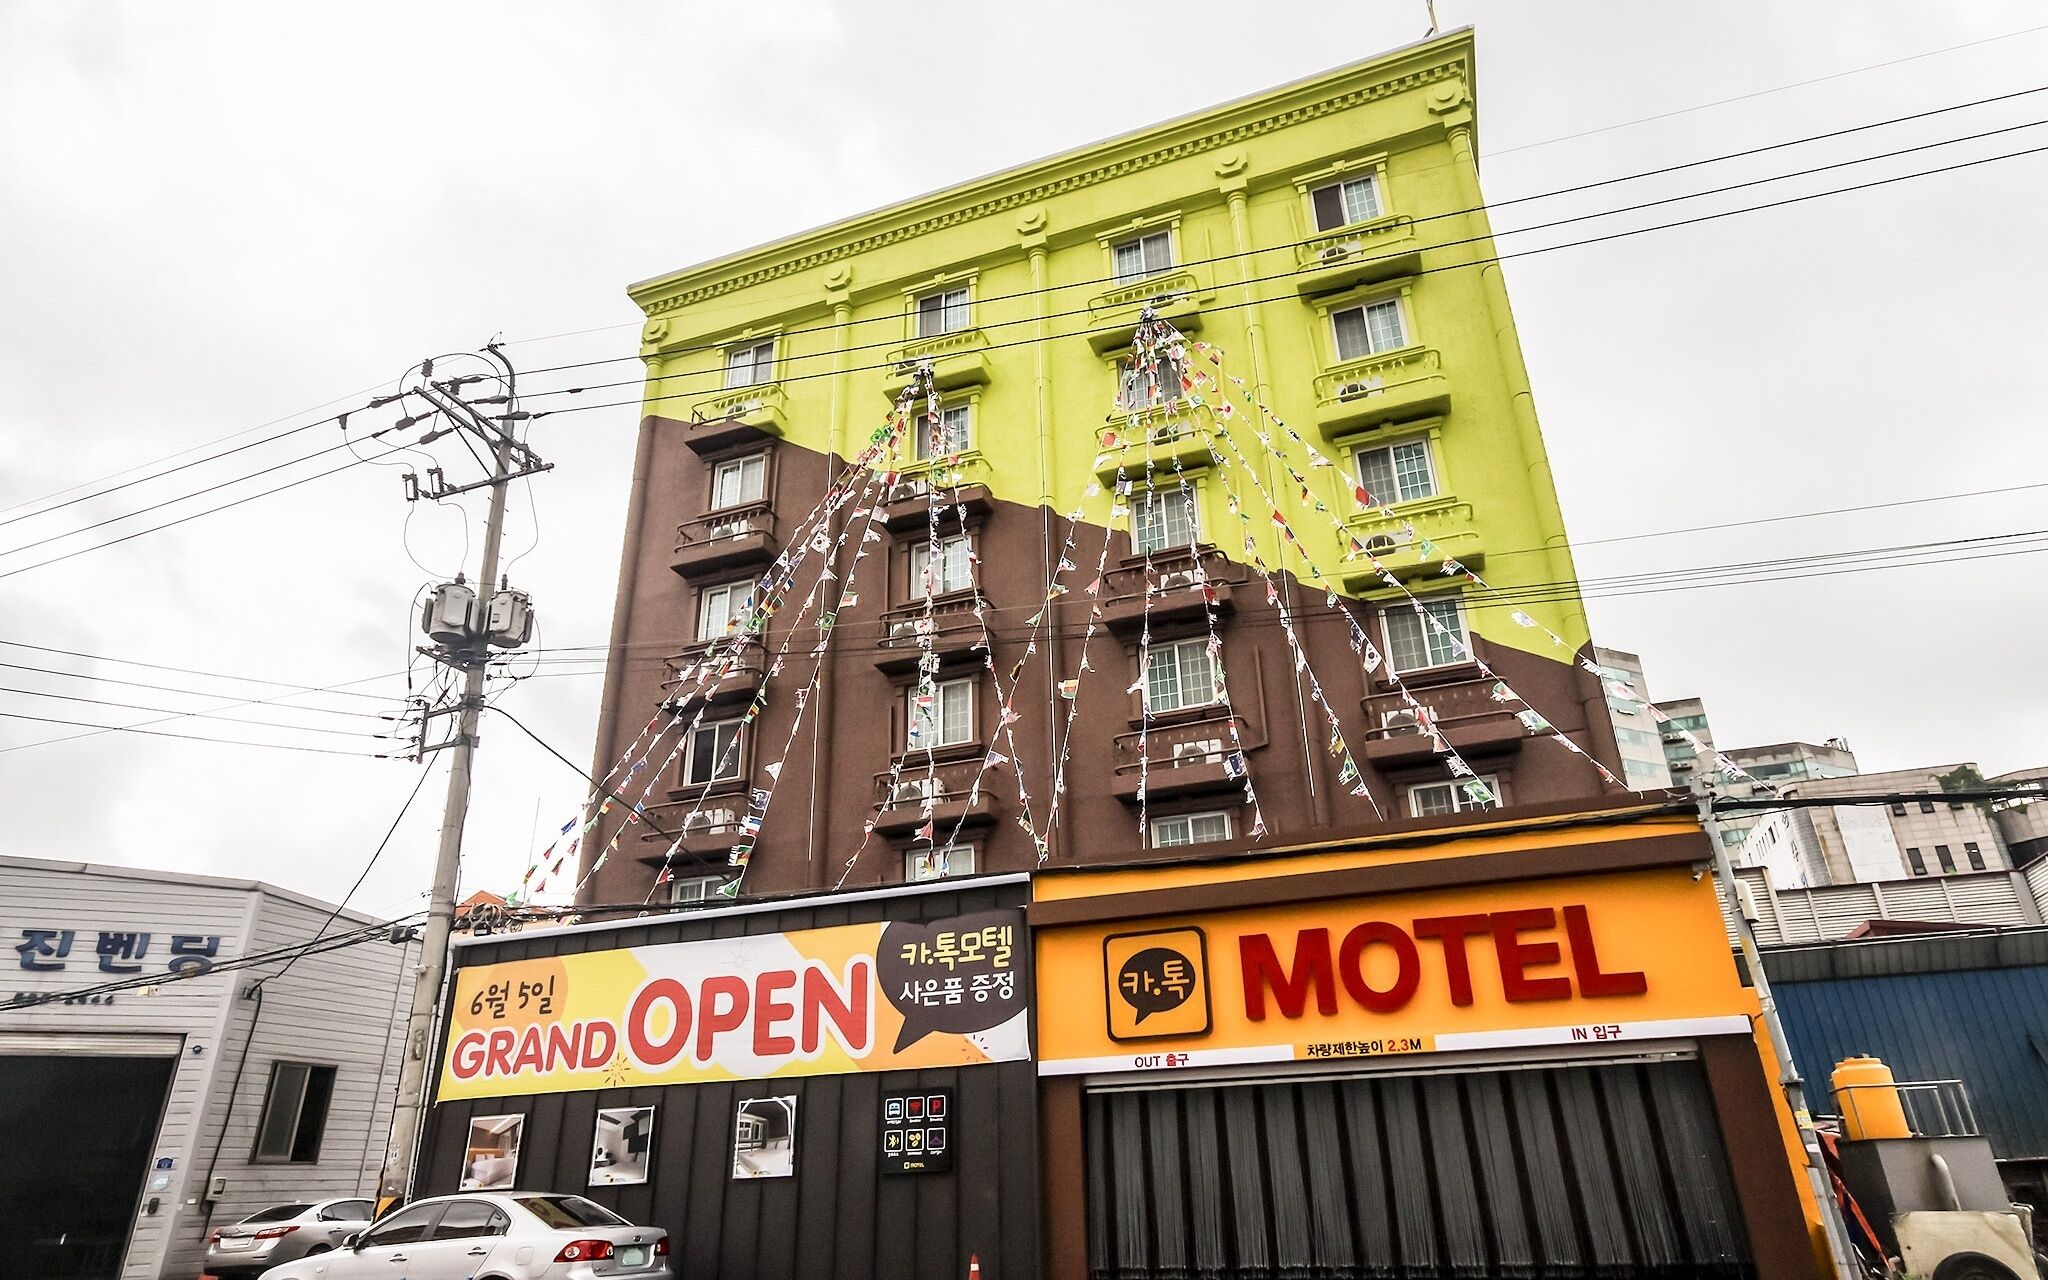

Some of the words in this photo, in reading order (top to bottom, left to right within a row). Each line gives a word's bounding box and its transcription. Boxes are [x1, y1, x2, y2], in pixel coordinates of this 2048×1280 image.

[1239, 904, 1648, 1022] MOTEL
[470, 980, 510, 1019] 6월
[518, 975, 555, 1014] 5일
[899, 977, 964, 1007] 사은품
[970, 970, 1014, 1003] 증정
[452, 1021, 616, 1079] GRAND
[628, 961, 868, 1065] OPEN
[1571, 1027, 1588, 1040] IN
[1592, 1025, 1622, 1040] 입구
[1134, 1056, 1161, 1068] OUT
[1165, 1053, 1190, 1067] 출구
[1387, 1038, 1422, 1052] 2.3M
